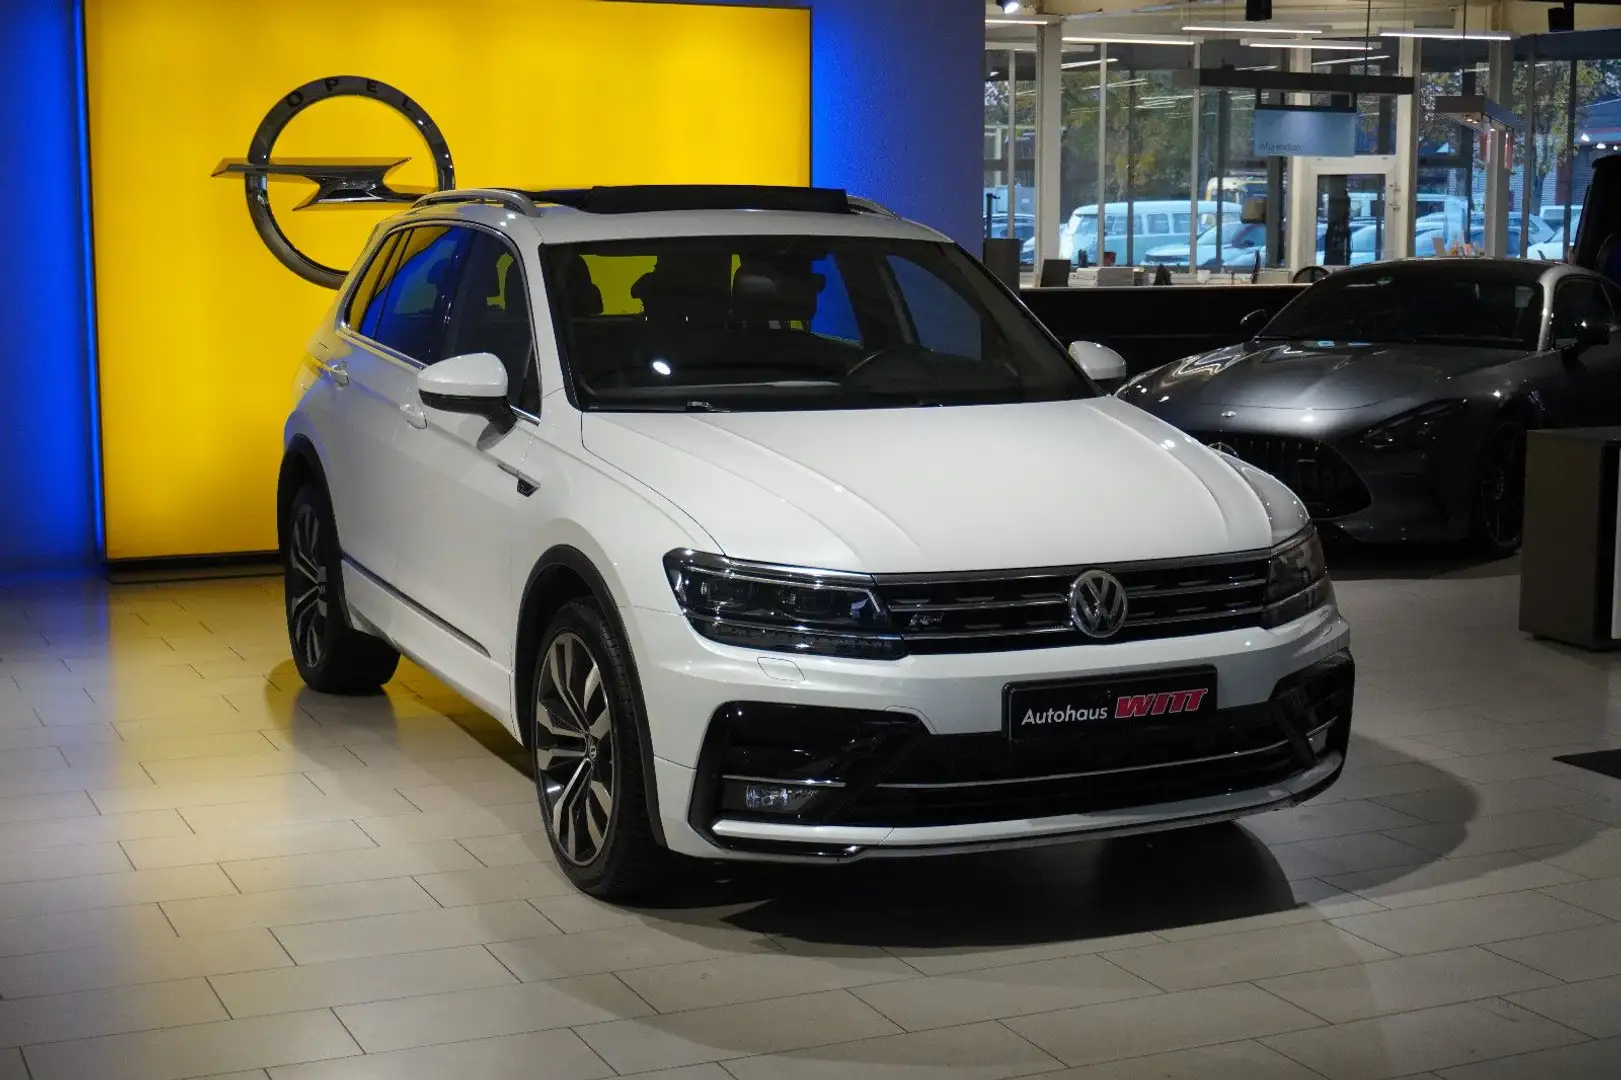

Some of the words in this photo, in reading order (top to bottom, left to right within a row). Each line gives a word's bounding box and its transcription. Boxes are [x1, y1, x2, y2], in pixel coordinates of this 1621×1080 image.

[287, 76, 412, 112] OPEL
[1069, 569, 1128, 638] VW
[1021, 704, 1108, 725] Autohaus
[1115, 688, 1208, 719] WITT
